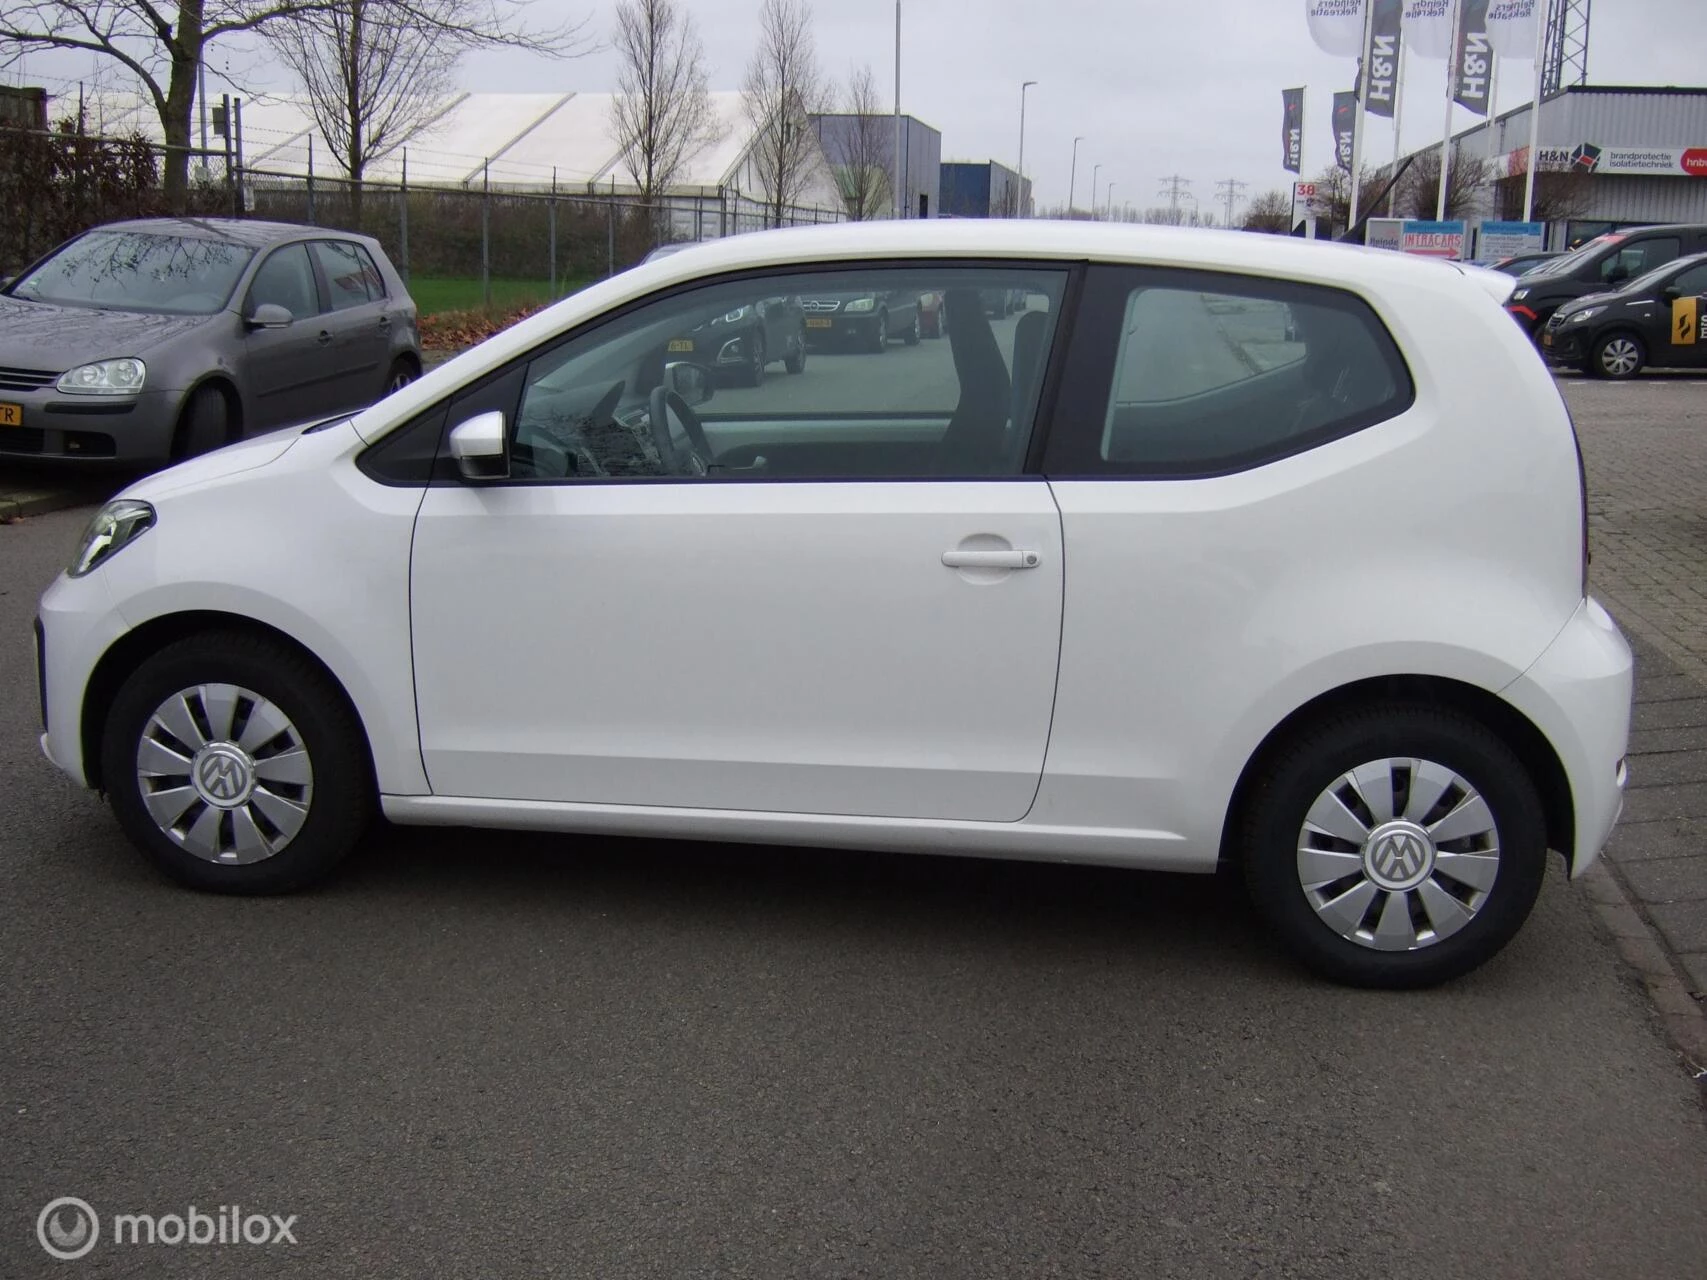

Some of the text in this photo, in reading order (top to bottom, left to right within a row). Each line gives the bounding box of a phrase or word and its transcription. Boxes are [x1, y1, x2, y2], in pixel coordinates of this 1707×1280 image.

[1539, 150, 1569, 161] H&N
[1610, 151, 1672, 161] brandprotectie
[1609, 160, 1674, 169] isolatietechniek
[1297, 184, 1316, 196] 38
[1405, 234, 1463, 248] INTRACARS
